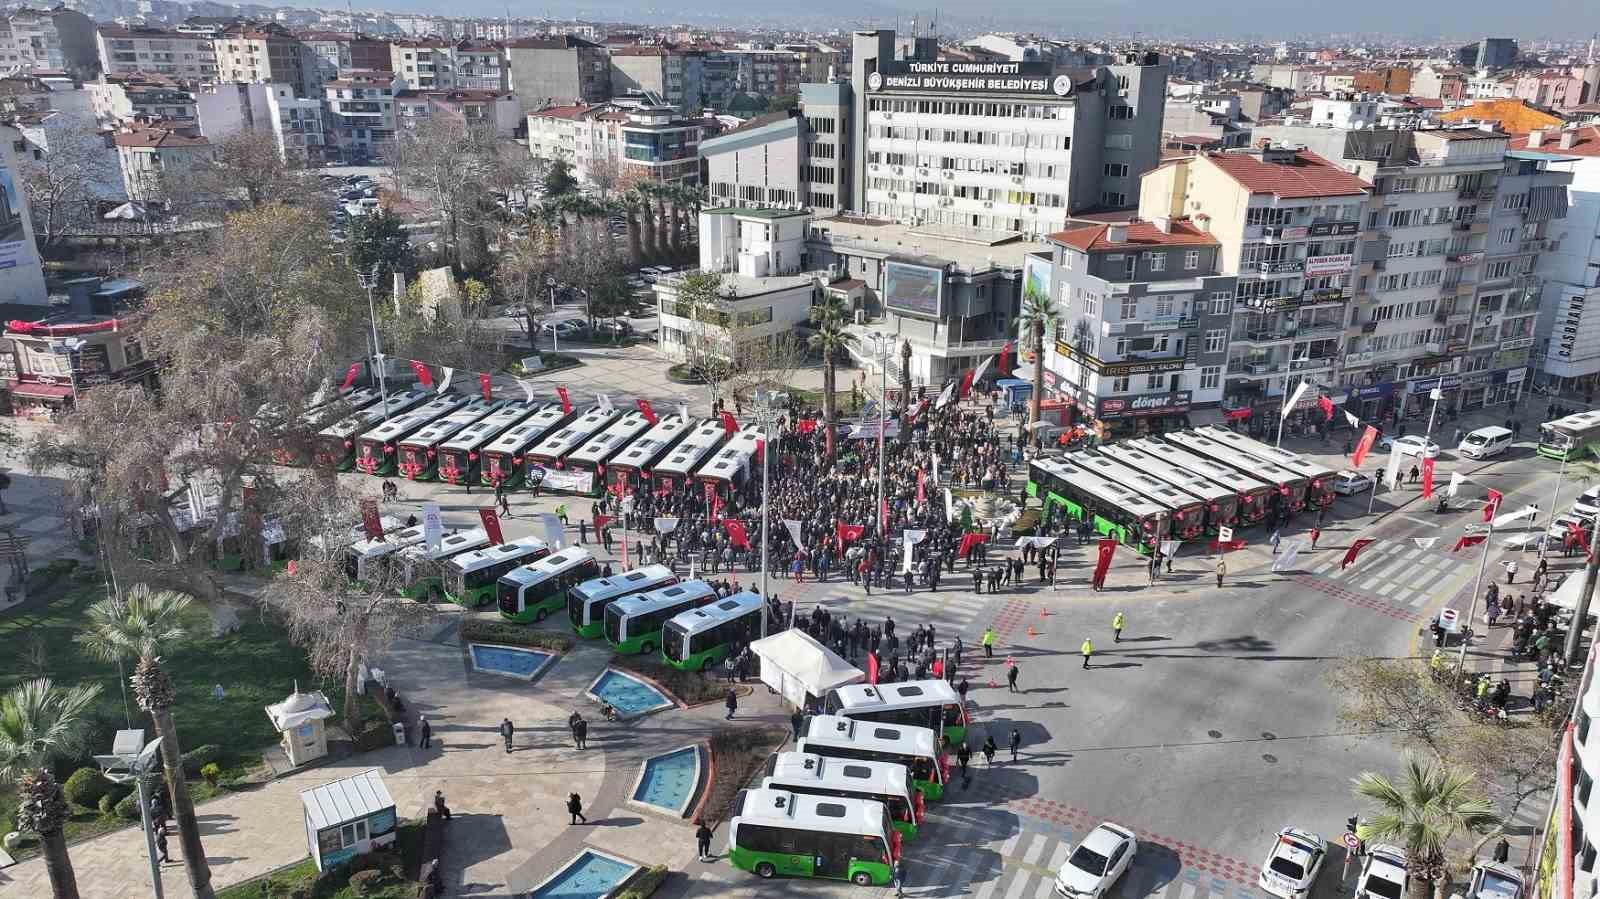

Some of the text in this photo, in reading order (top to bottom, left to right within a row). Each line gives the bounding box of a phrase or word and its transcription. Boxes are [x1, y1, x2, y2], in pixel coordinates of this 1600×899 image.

[909, 63, 1019, 74] TÜRKİYE CUMHURİYETİ
[886, 76, 1048, 91] DENİZLİ BÜYÜKŞEHİR BELEDİYESİ
[1131, 396, 1171, 409] döner
